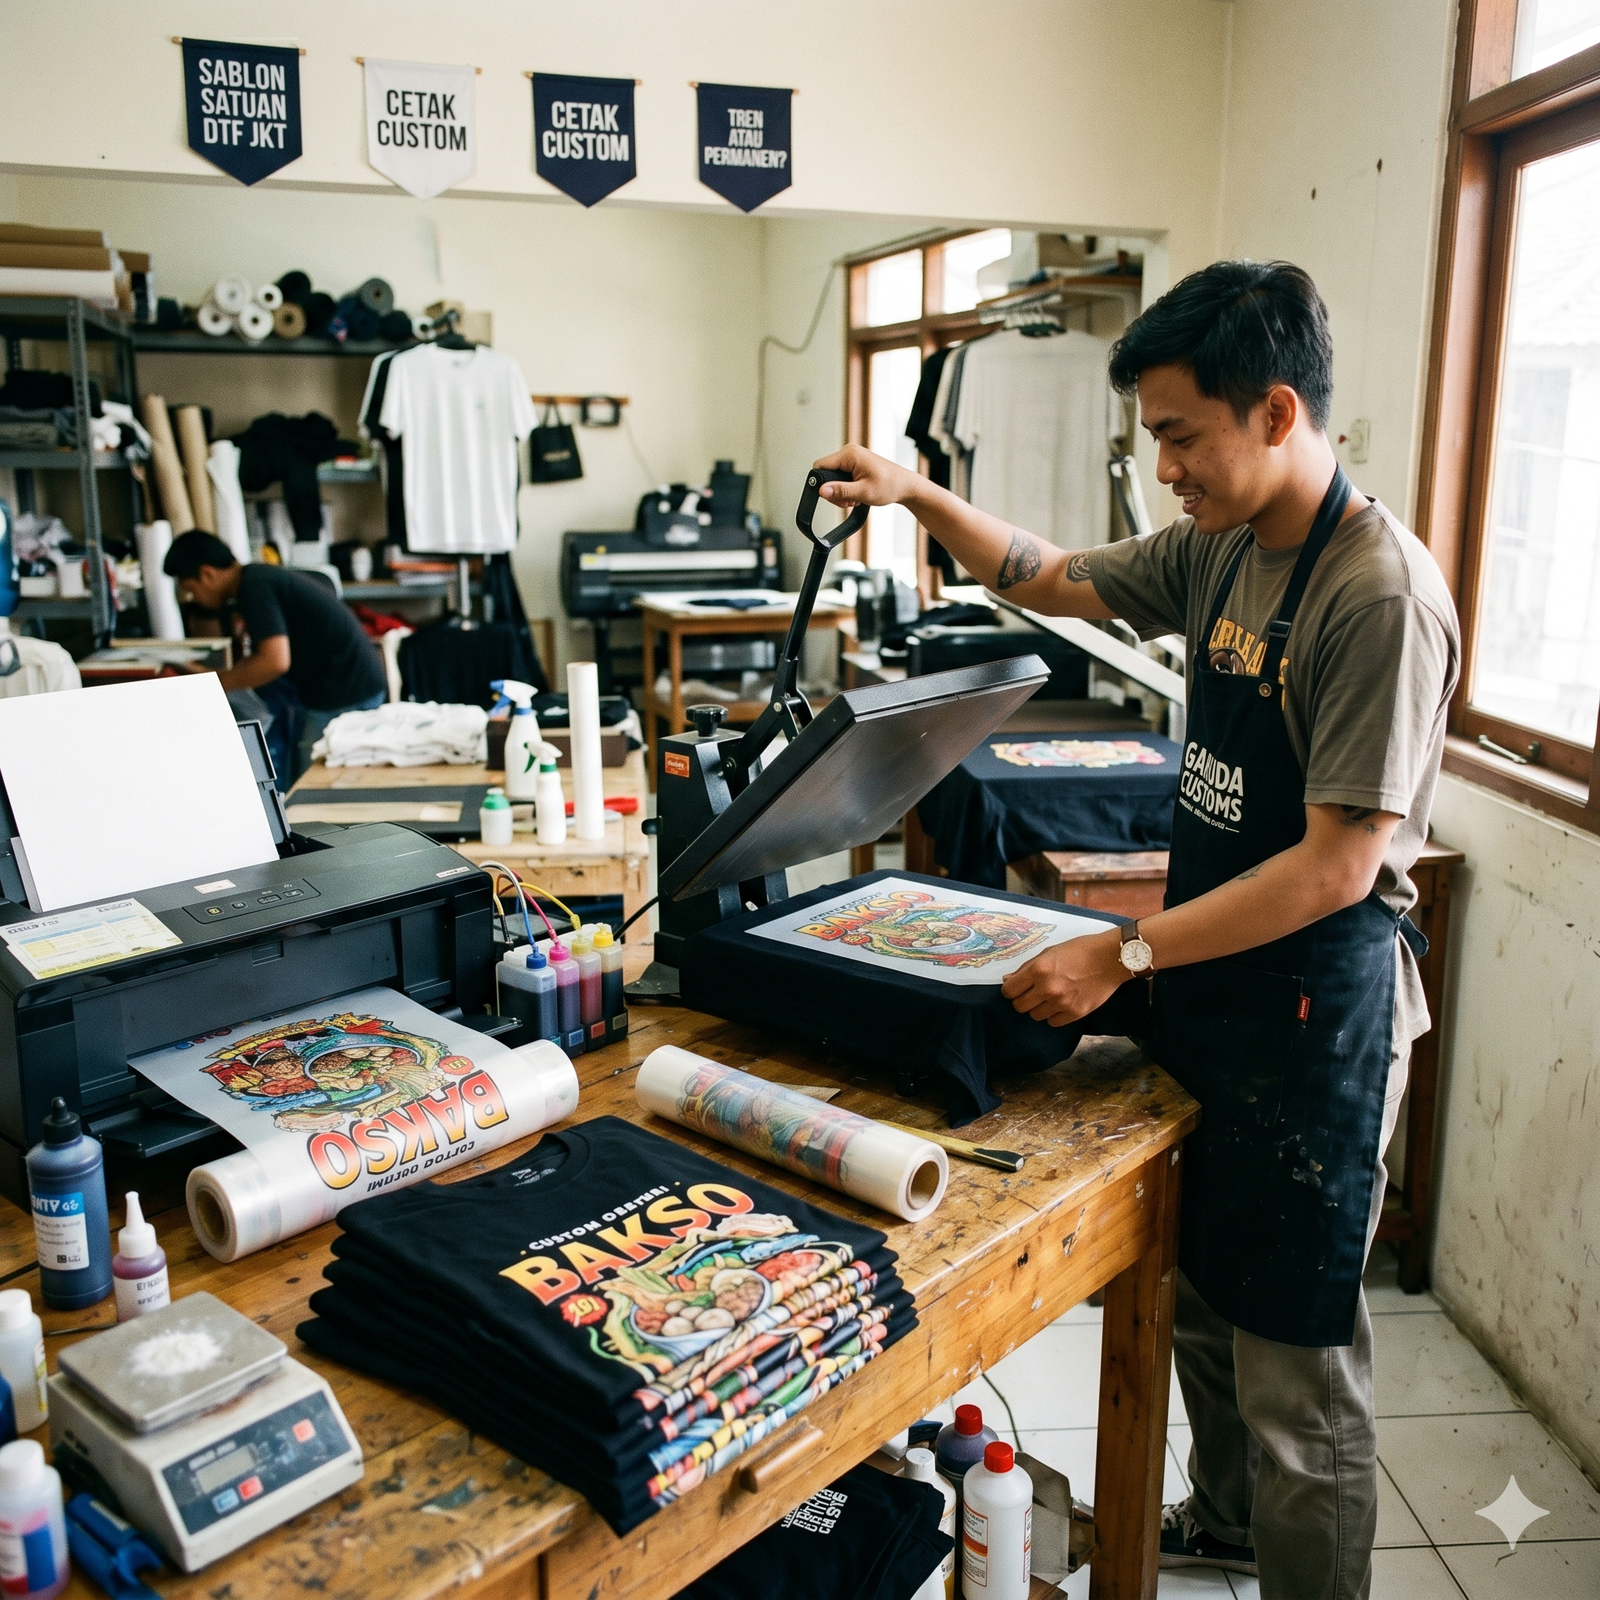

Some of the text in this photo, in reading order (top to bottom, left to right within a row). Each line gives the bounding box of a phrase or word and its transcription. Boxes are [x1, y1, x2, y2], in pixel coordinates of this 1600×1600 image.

[198, 57, 286, 92] SABLON
[201, 87, 287, 121] SATUAN
[386, 89, 456, 120] CETAK
[551, 100, 620, 132] CETAK
[727, 108, 764, 129] TREN
[203, 117, 288, 150] DTF JKT
[377, 119, 467, 151] CUSTOM
[542, 129, 630, 162] CUSTOM
[727, 128, 764, 149] ATAU
[704, 146, 788, 169] PERMANEN?
[1180, 770, 1243, 822] CUSTOMS
[792, 890, 936, 941] BAKSO
[306, 1069, 510, 1191] BAKSO
[499, 1182, 755, 1307] BAKSO
[528, 1218, 602, 1252] CUSTOM
